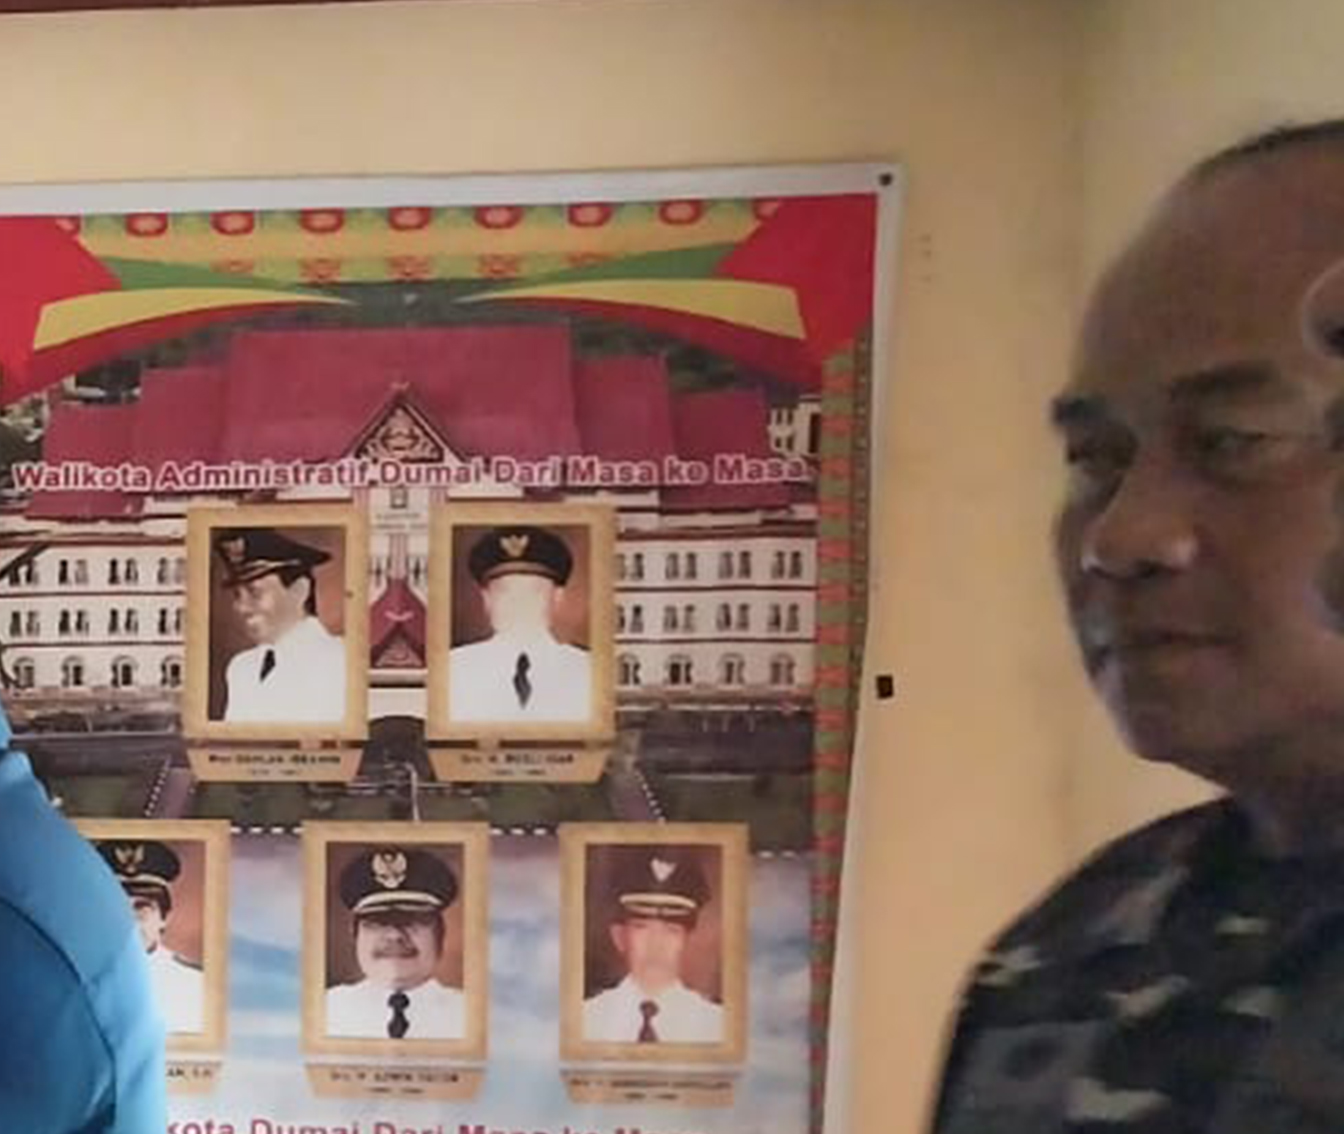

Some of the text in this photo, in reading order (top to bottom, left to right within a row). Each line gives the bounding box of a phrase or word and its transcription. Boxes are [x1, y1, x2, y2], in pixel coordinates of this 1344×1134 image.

[158, 461, 369, 489] Administratif
[380, 460, 481, 485] Dumai
[494, 459, 560, 483] Dari
[569, 458, 662, 484] Masa
[666, 456, 707, 482] ke
[716, 456, 804, 482] Masa
